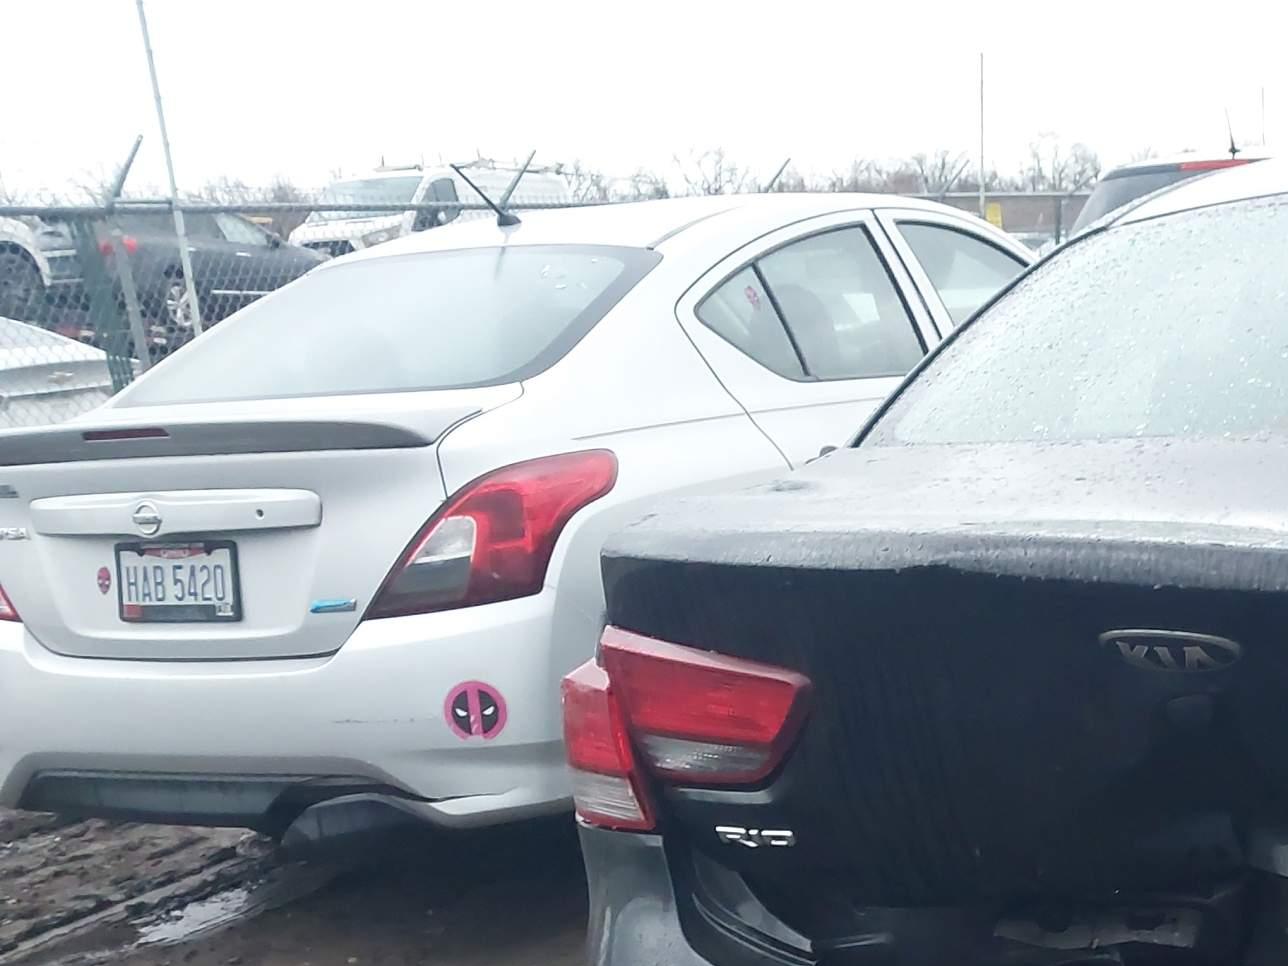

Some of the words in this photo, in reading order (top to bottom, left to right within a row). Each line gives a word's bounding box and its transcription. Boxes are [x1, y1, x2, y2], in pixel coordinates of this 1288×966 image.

[125, 565, 166, 602] HAB
[172, 564, 226, 602] 5420
[1111, 637, 1221, 671] KIA
[714, 825, 797, 848] RIO
